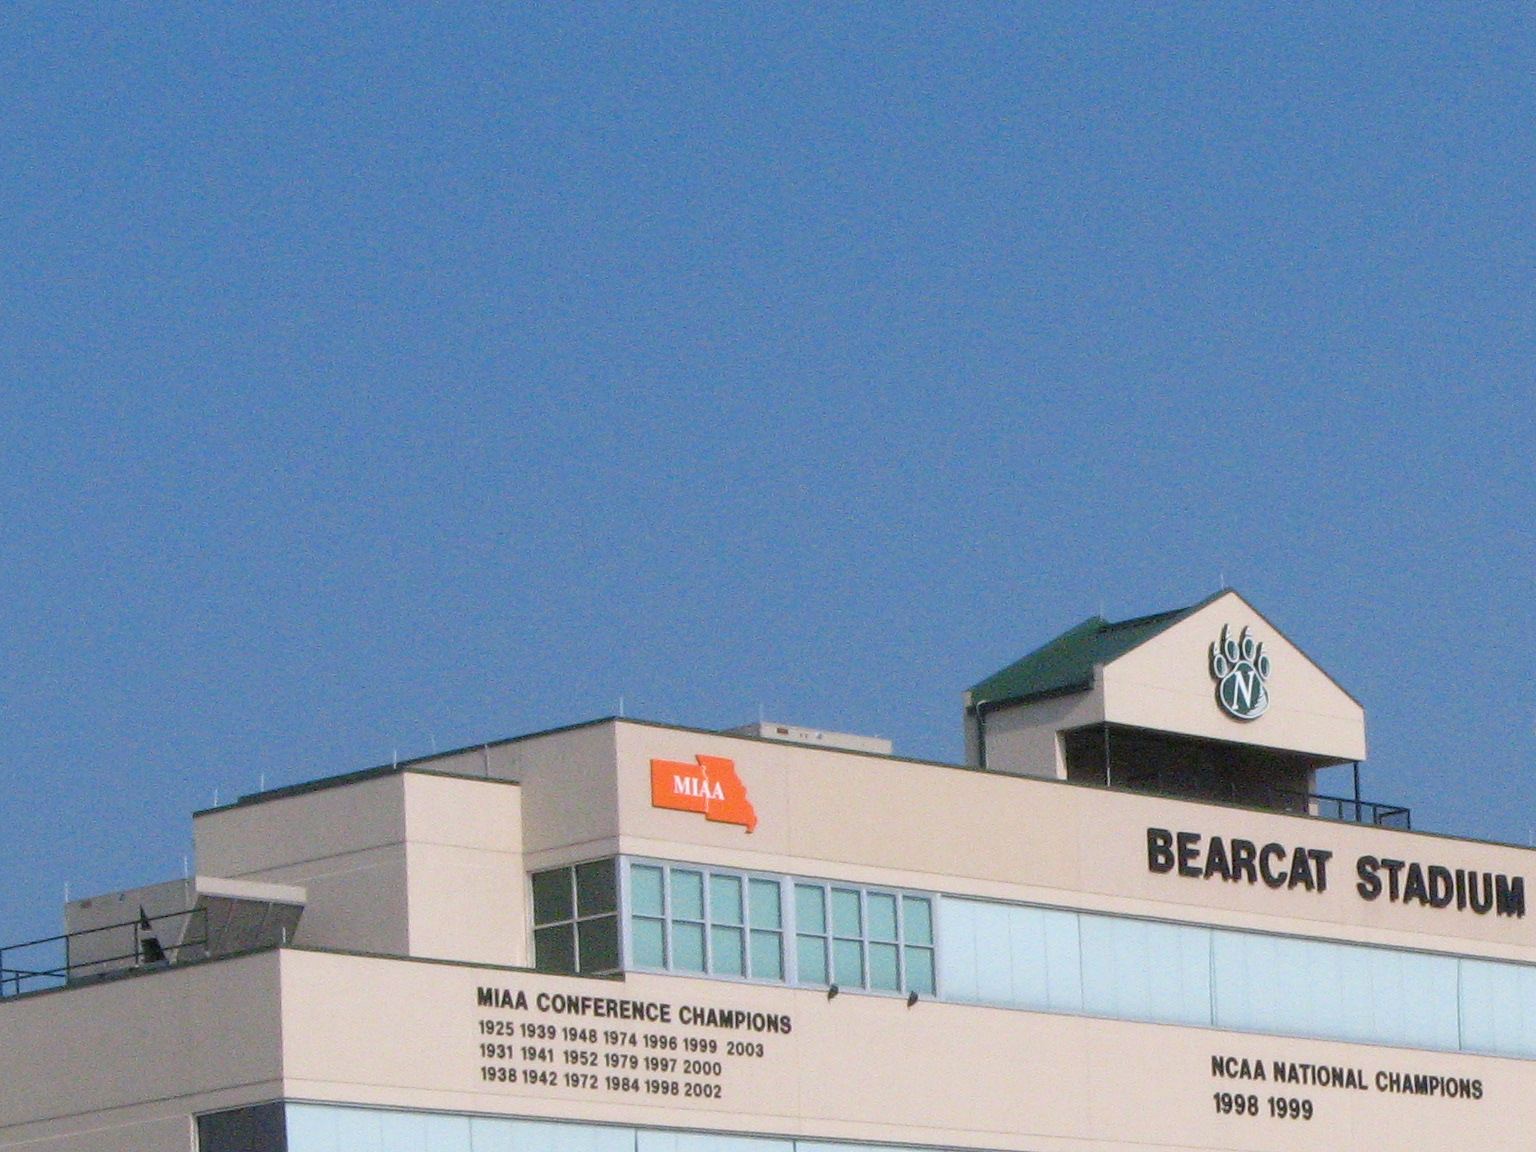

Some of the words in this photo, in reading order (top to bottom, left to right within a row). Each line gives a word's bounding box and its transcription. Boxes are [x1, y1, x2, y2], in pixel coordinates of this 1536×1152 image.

[1232, 670, 1256, 710] N
[673, 774, 725, 801] MIAA
[1146, 827, 1333, 894] BEARCAT
[1356, 855, 1526, 919] STADIUM
[477, 986, 529, 1011] MIAA
[536, 992, 672, 1023] CONFERENCE
[678, 1005, 792, 1035] CHAMPIONS
[478, 1019, 515, 1037] 1925
[519, 1023, 557, 1040] 1939
[562, 1026, 598, 1044] 1948
[603, 1030, 638, 1047] 1974
[643, 1033, 678, 1051] 1996
[683, 1037, 718, 1054] 1999
[726, 1040, 764, 1058] 2003
[479, 1043, 513, 1060] 1931
[520, 1046, 554, 1063] 1941
[563, 1049, 598, 1067] 1952
[604, 1052, 639, 1070] 1979
[643, 1056, 677, 1073] 1997
[683, 1059, 722, 1077] 2000
[1211, 1055, 1267, 1081] NCAA
[1273, 1061, 1369, 1091] NATIONAL
[1375, 1070, 1484, 1100] CHAMPIONS
[480, 1066, 518, 1083] 1938
[522, 1069, 558, 1087] 1942
[563, 1072, 599, 1090] 1972
[605, 1075, 640, 1093] 1984
[644, 1079, 680, 1096] 1998
[684, 1082, 722, 1099] 2002
[1213, 1092, 1259, 1117] 1998
[1267, 1096, 1314, 1121] 1999
